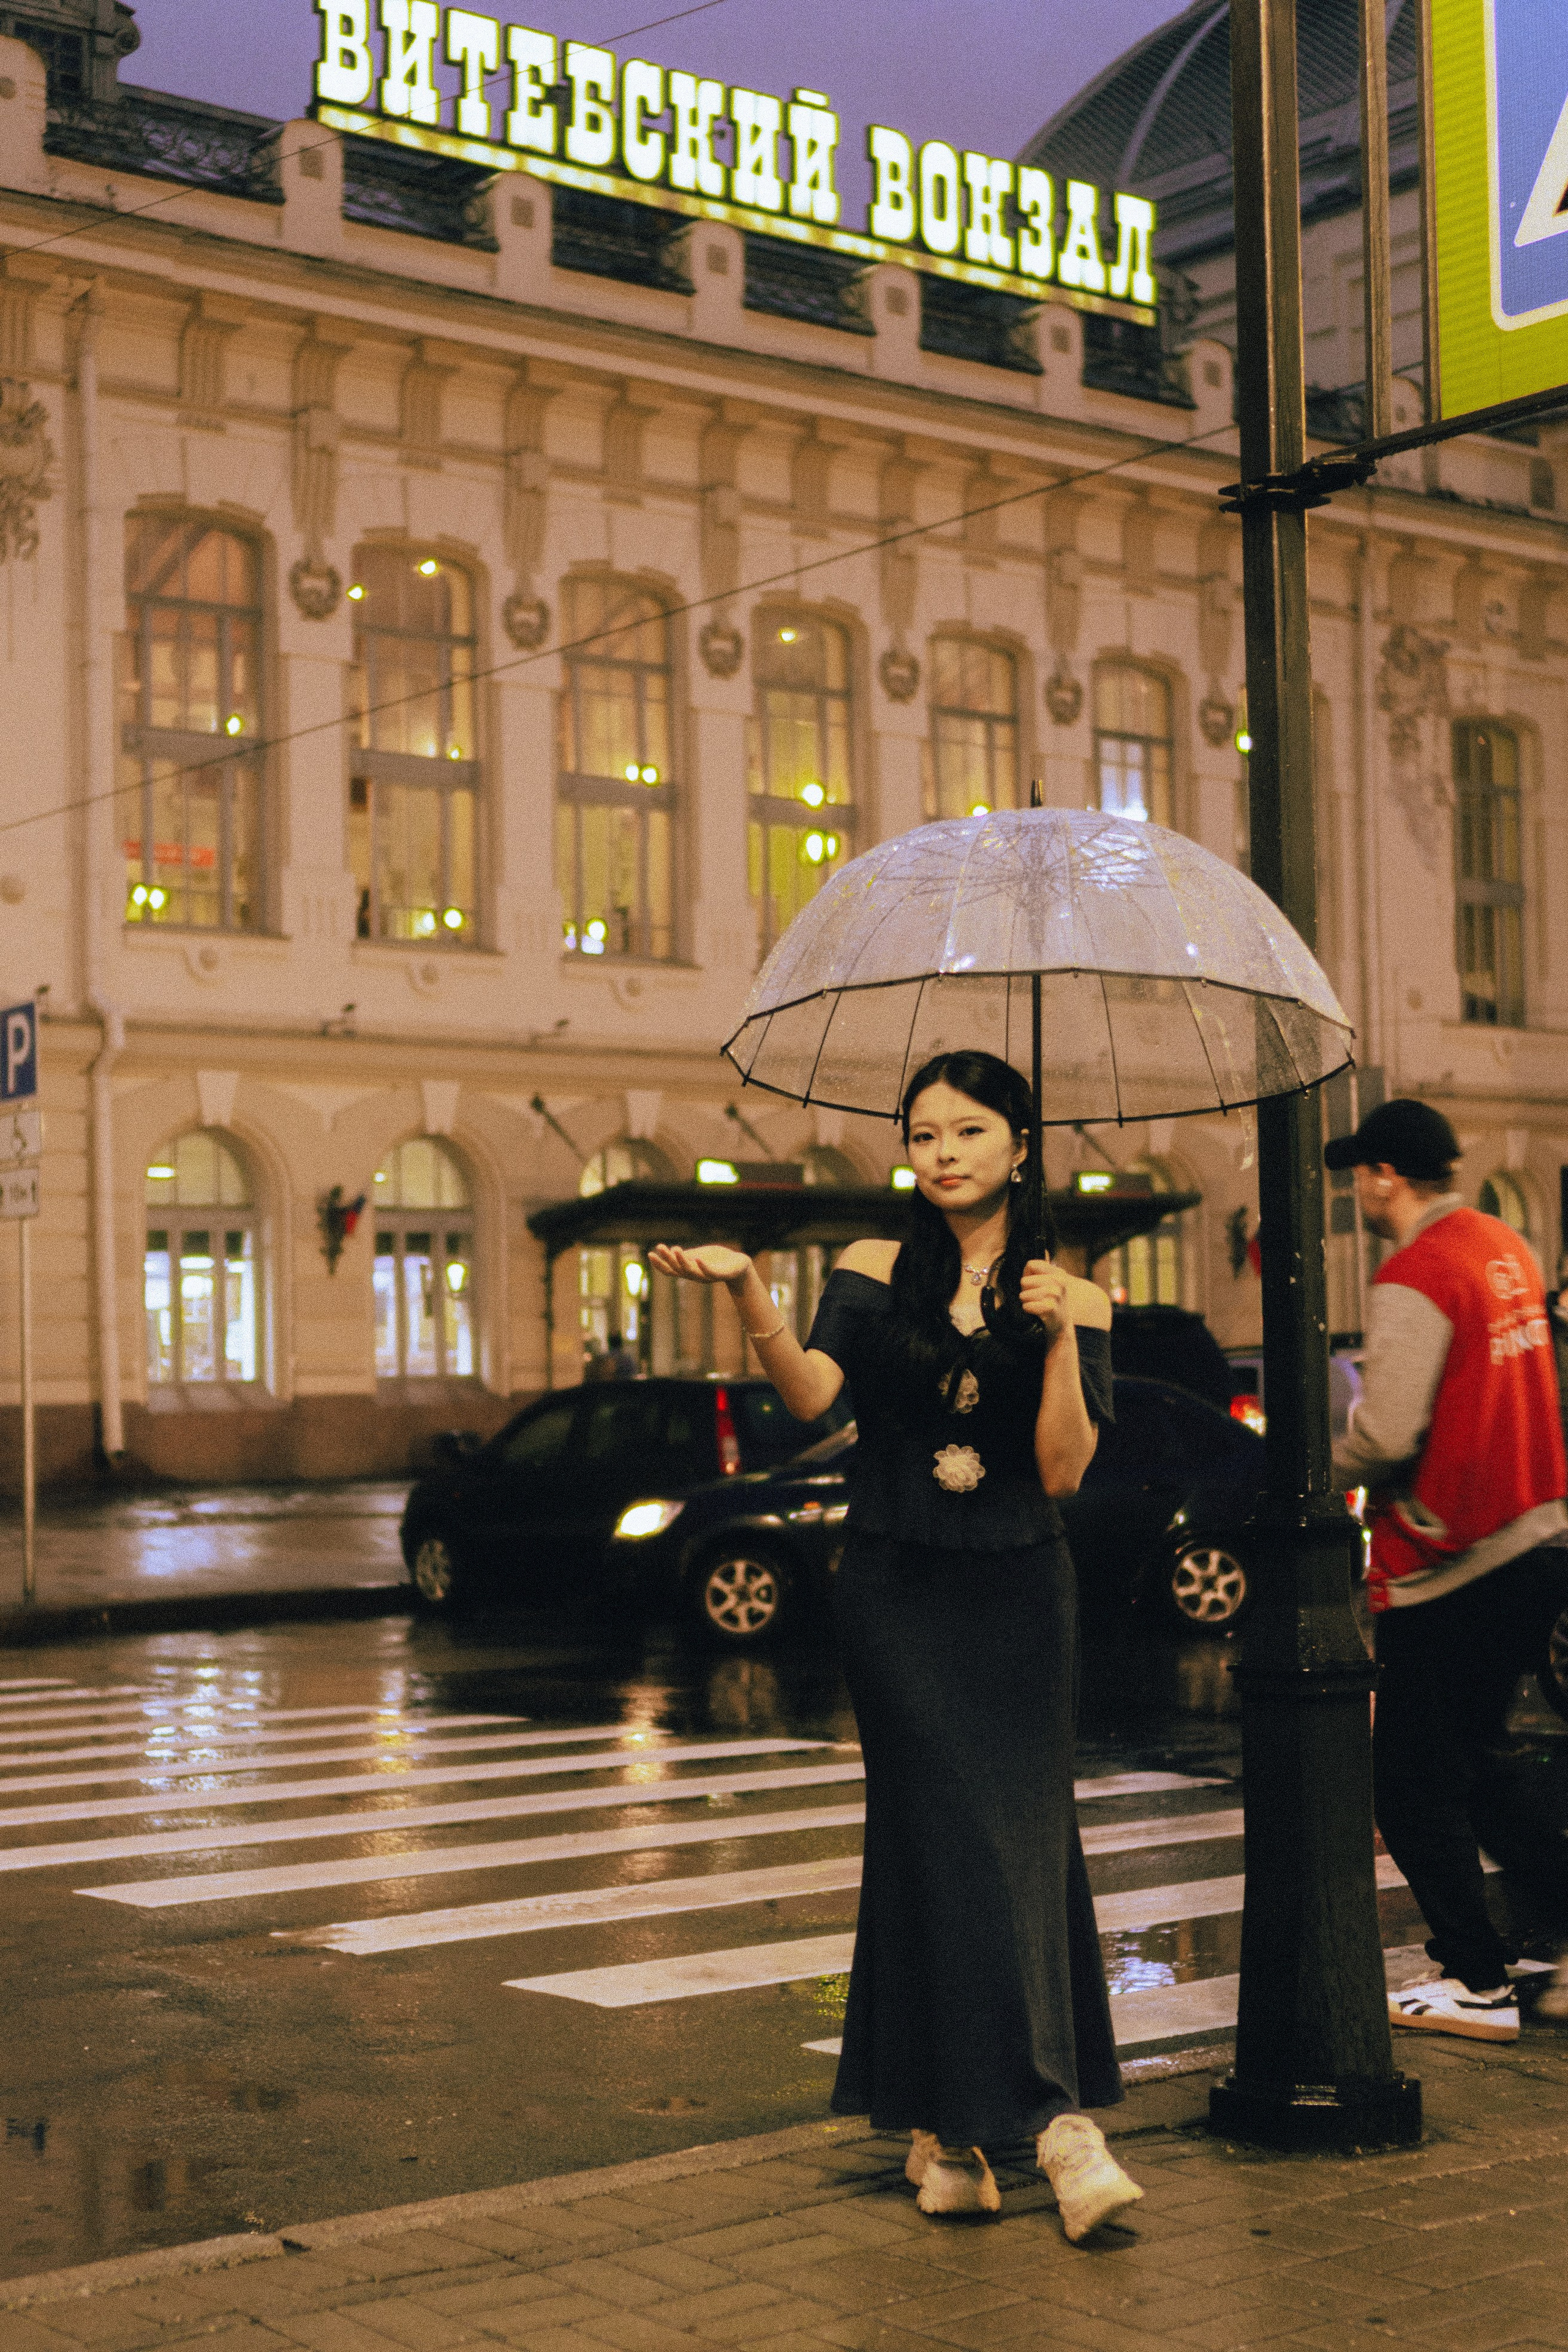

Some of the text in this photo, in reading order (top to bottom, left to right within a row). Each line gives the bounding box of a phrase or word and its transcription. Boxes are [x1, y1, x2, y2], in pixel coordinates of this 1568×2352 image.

[315, 0, 1157, 306] ВИТЕБСКИЙ ВОКЗАЛ
[7, 1012, 31, 1094] P
